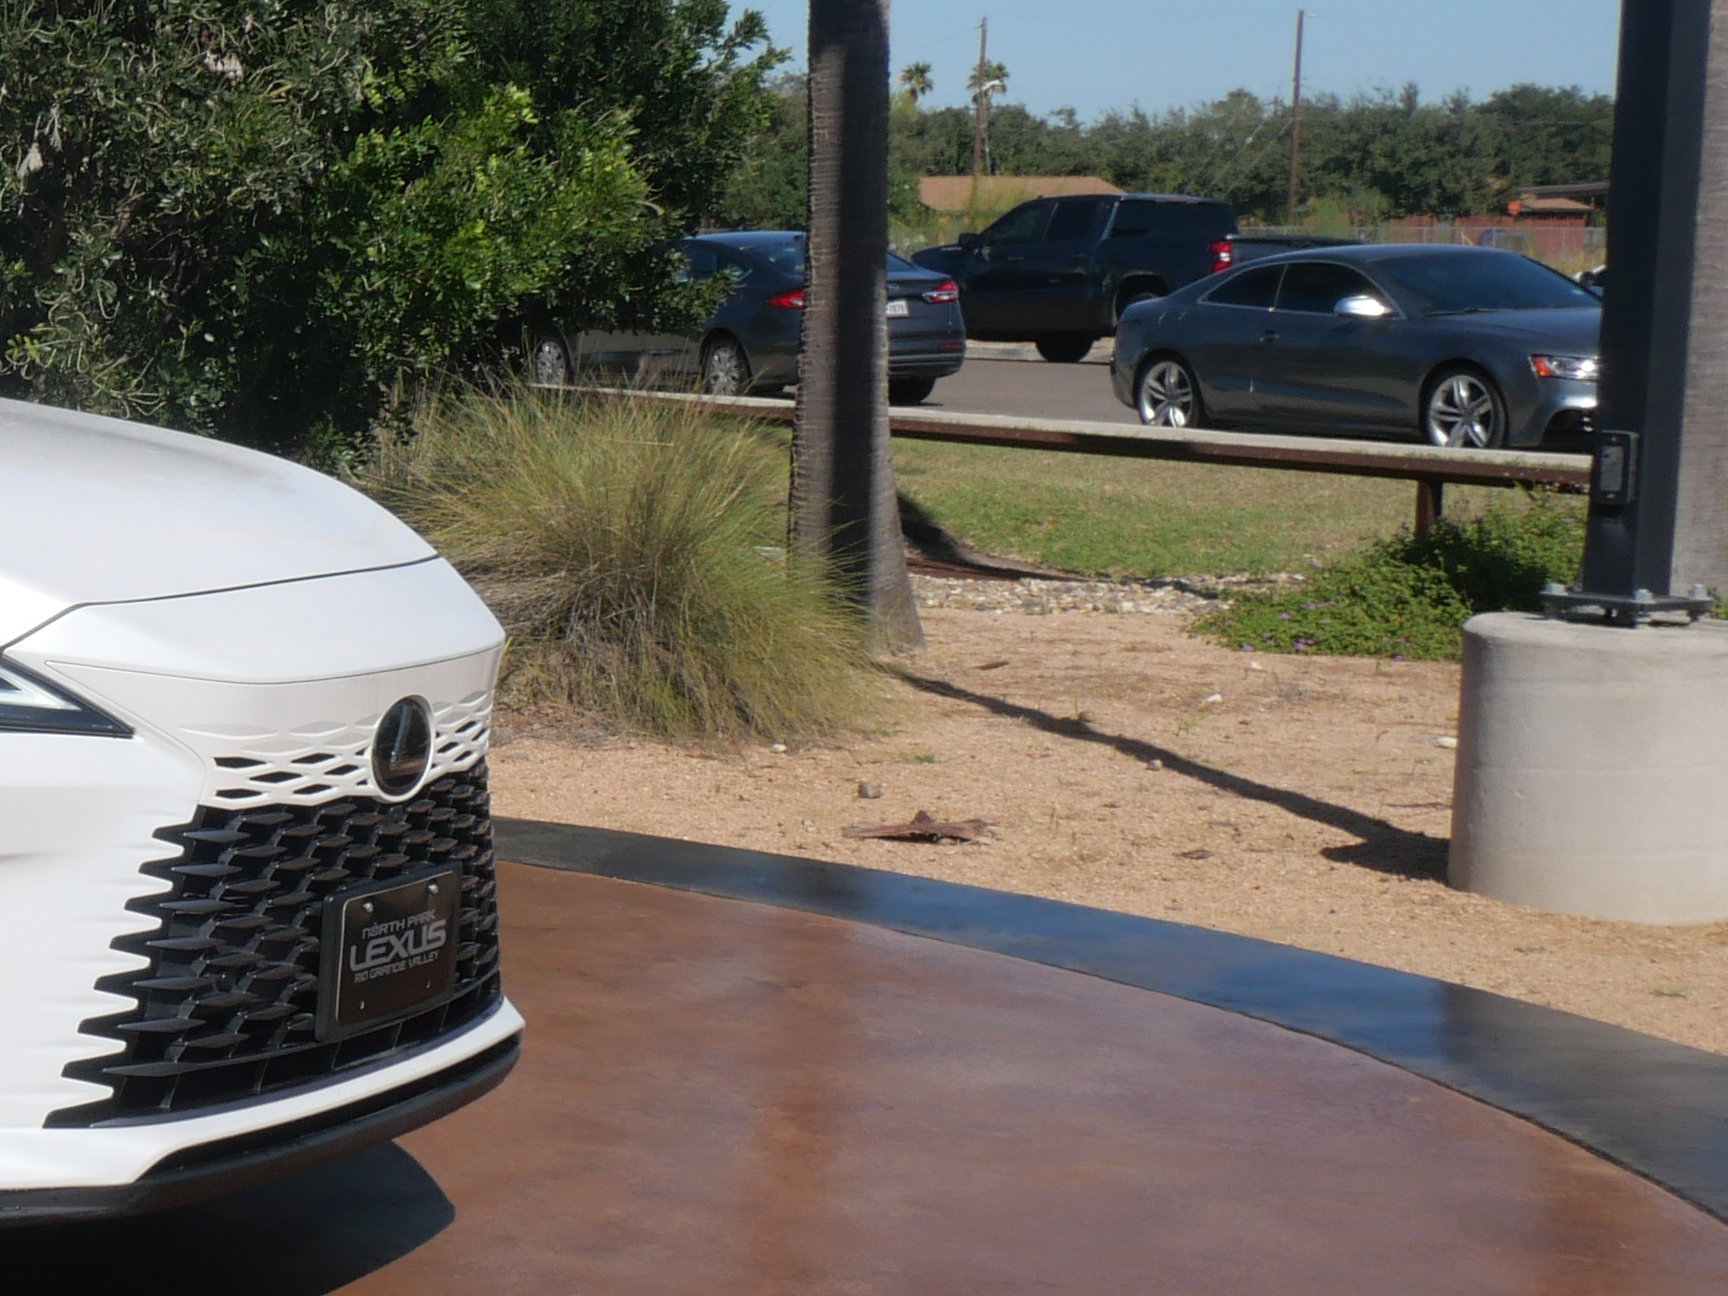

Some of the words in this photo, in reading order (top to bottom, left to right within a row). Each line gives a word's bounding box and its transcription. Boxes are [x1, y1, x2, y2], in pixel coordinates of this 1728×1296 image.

[407, 909, 436, 927] PARK
[350, 919, 446, 971] LEXUS
[355, 971, 369, 983] RIO
[369, 961, 407, 979] GRANDE
[408, 950, 439, 968] VALLEY
